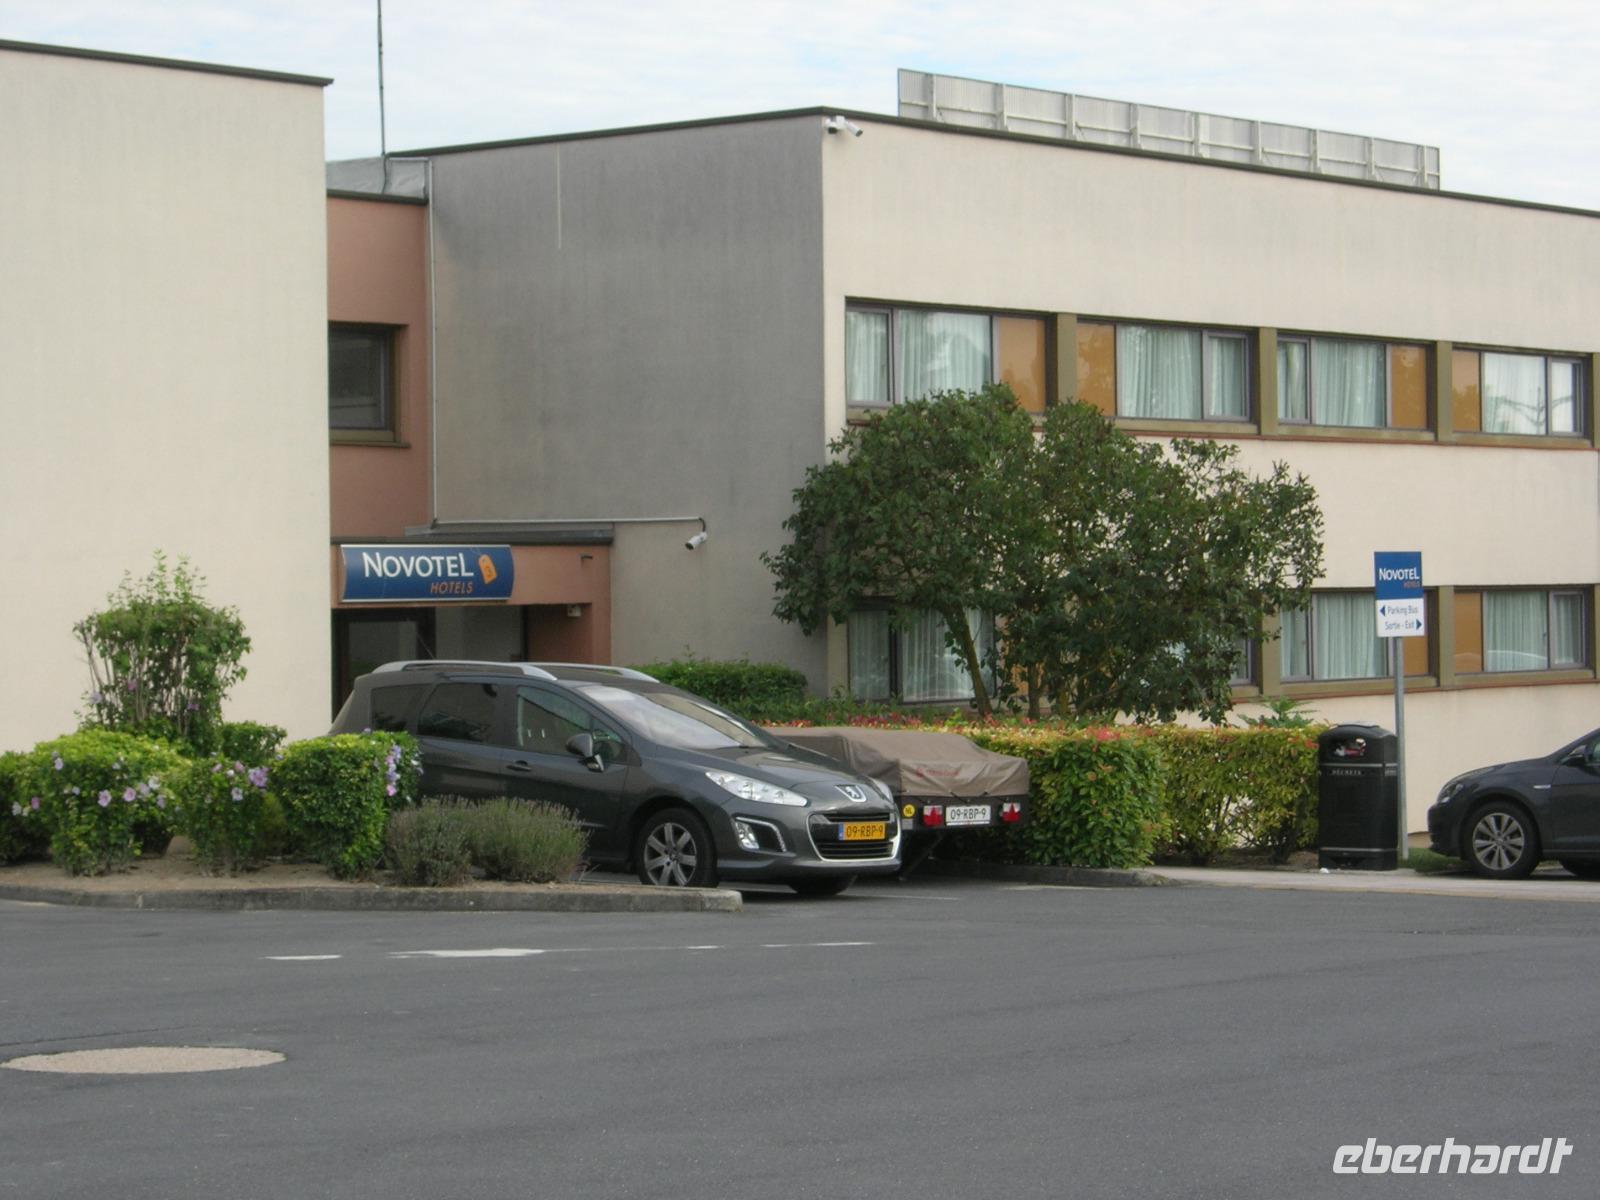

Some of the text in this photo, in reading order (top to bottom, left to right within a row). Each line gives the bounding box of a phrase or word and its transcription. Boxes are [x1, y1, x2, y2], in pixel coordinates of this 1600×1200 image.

[362, 552, 474, 577] NOVOTEL
[1379, 567, 1420, 580] NOVOTEL
[430, 581, 474, 594] HOTELS
[1388, 606, 1418, 616] Parking Bus
[1405, 621, 1414, 629] Exit
[950, 807, 987, 820] 09-RBP-9
[846, 825, 884, 838] 09-RBP-9
